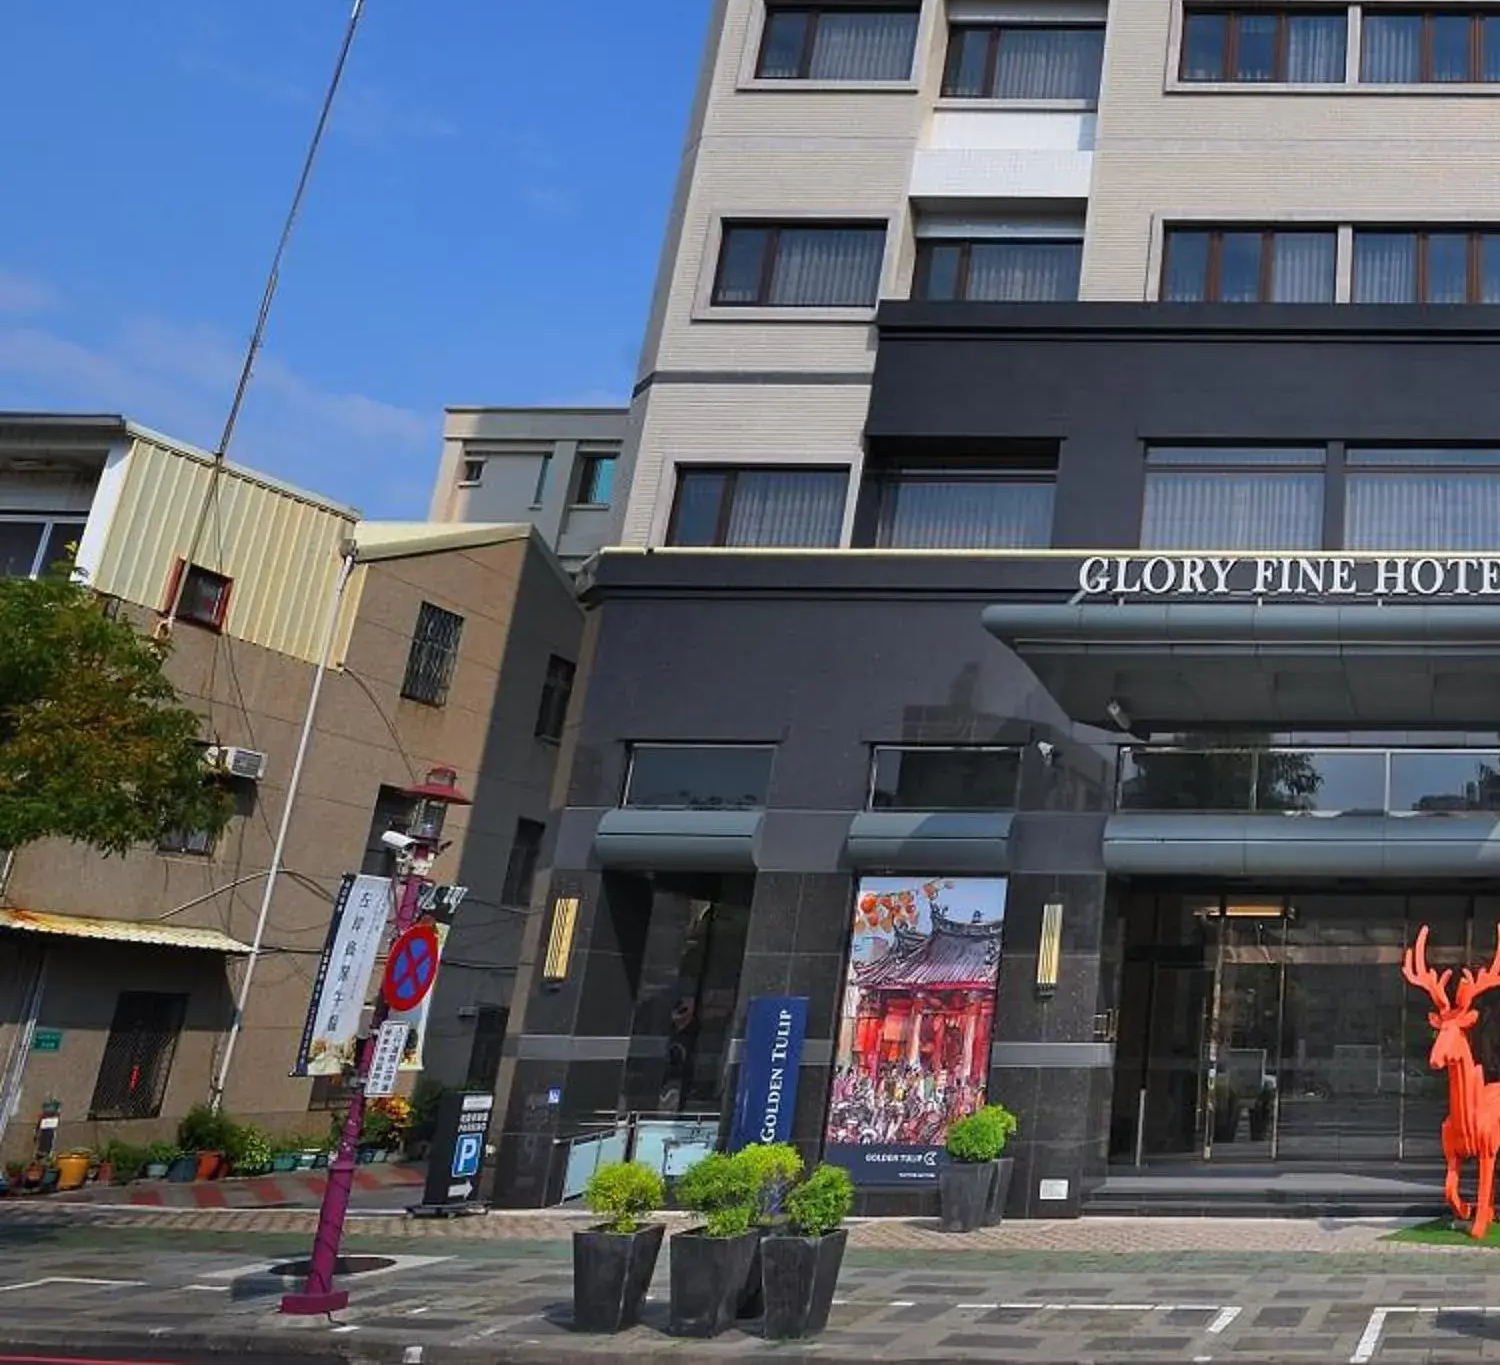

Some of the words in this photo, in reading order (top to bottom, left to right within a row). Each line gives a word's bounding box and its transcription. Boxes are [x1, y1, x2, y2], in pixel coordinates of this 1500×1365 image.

[1079, 557, 1236, 596] GLORY
[1256, 559, 1360, 596] FINE
[760, 1068, 784, 1143] GOLDEN
[772, 1009, 792, 1062] TULIP
[458, 1139, 477, 1172] P
